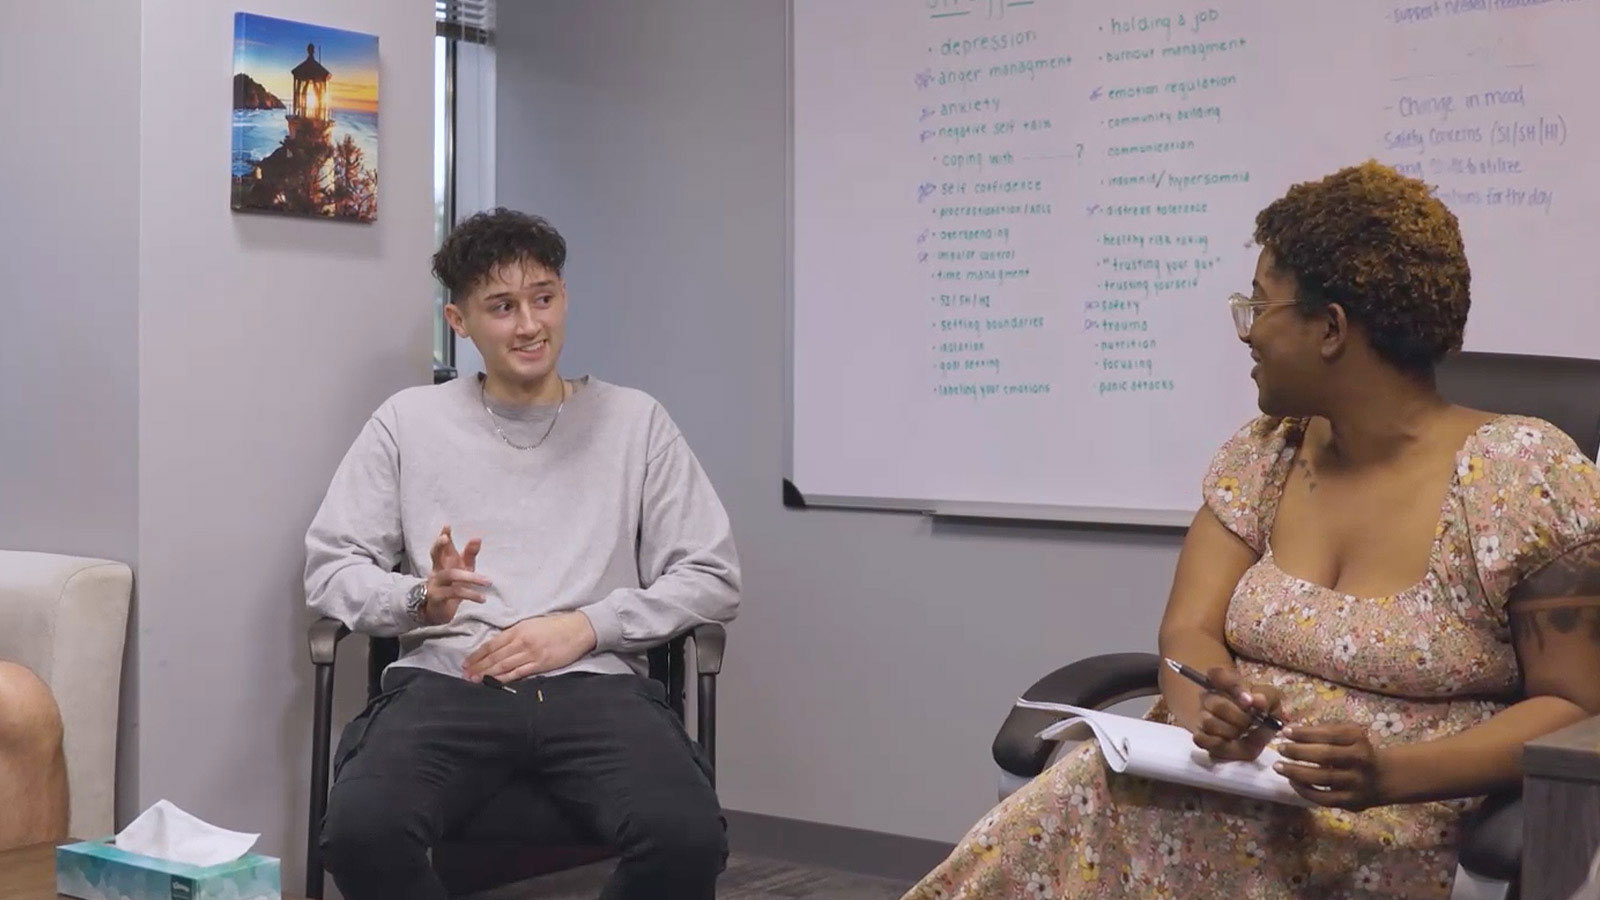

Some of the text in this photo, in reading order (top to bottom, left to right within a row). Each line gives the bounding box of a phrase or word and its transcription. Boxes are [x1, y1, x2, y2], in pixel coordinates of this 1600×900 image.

[1111, 9, 1220, 41] holding a job
[941, 30, 1037, 56] depression
[1106, 48, 1155, 62] burnout
[938, 69, 981, 87] anger
[1108, 75, 1237, 100] emotion regulation
[940, 99, 1000, 116] anxiety
[1399, 84, 1525, 121] Change in mood
[1108, 106, 1221, 129] community building
[938, 119, 1052, 142] negative self talk
[1107, 140, 1195, 156] communication
[942, 152, 982, 169] coping
[988, 151, 1013, 164] with
[974, 180, 1042, 194] confidence
[1528, 187, 1553, 215] day
[1106, 203, 1208, 216] distress tolerance
[940, 228, 1010, 243] overspending
[1102, 234, 1208, 252] healthy risk taking
[980, 250, 1015, 260] control
[1166, 260, 1188, 275] your
[1104, 278, 1198, 298] trusting yourself
[985, 316, 1044, 330] boundaries
[1101, 320, 1148, 332] trauma
[940, 341, 984, 353] isolation
[1100, 339, 1157, 350] nutrition
[940, 360, 960, 374] goal
[1102, 359, 1153, 375] focusing
[1002, 384, 1050, 395] emotions
[1099, 380, 1175, 395] panic attacks
